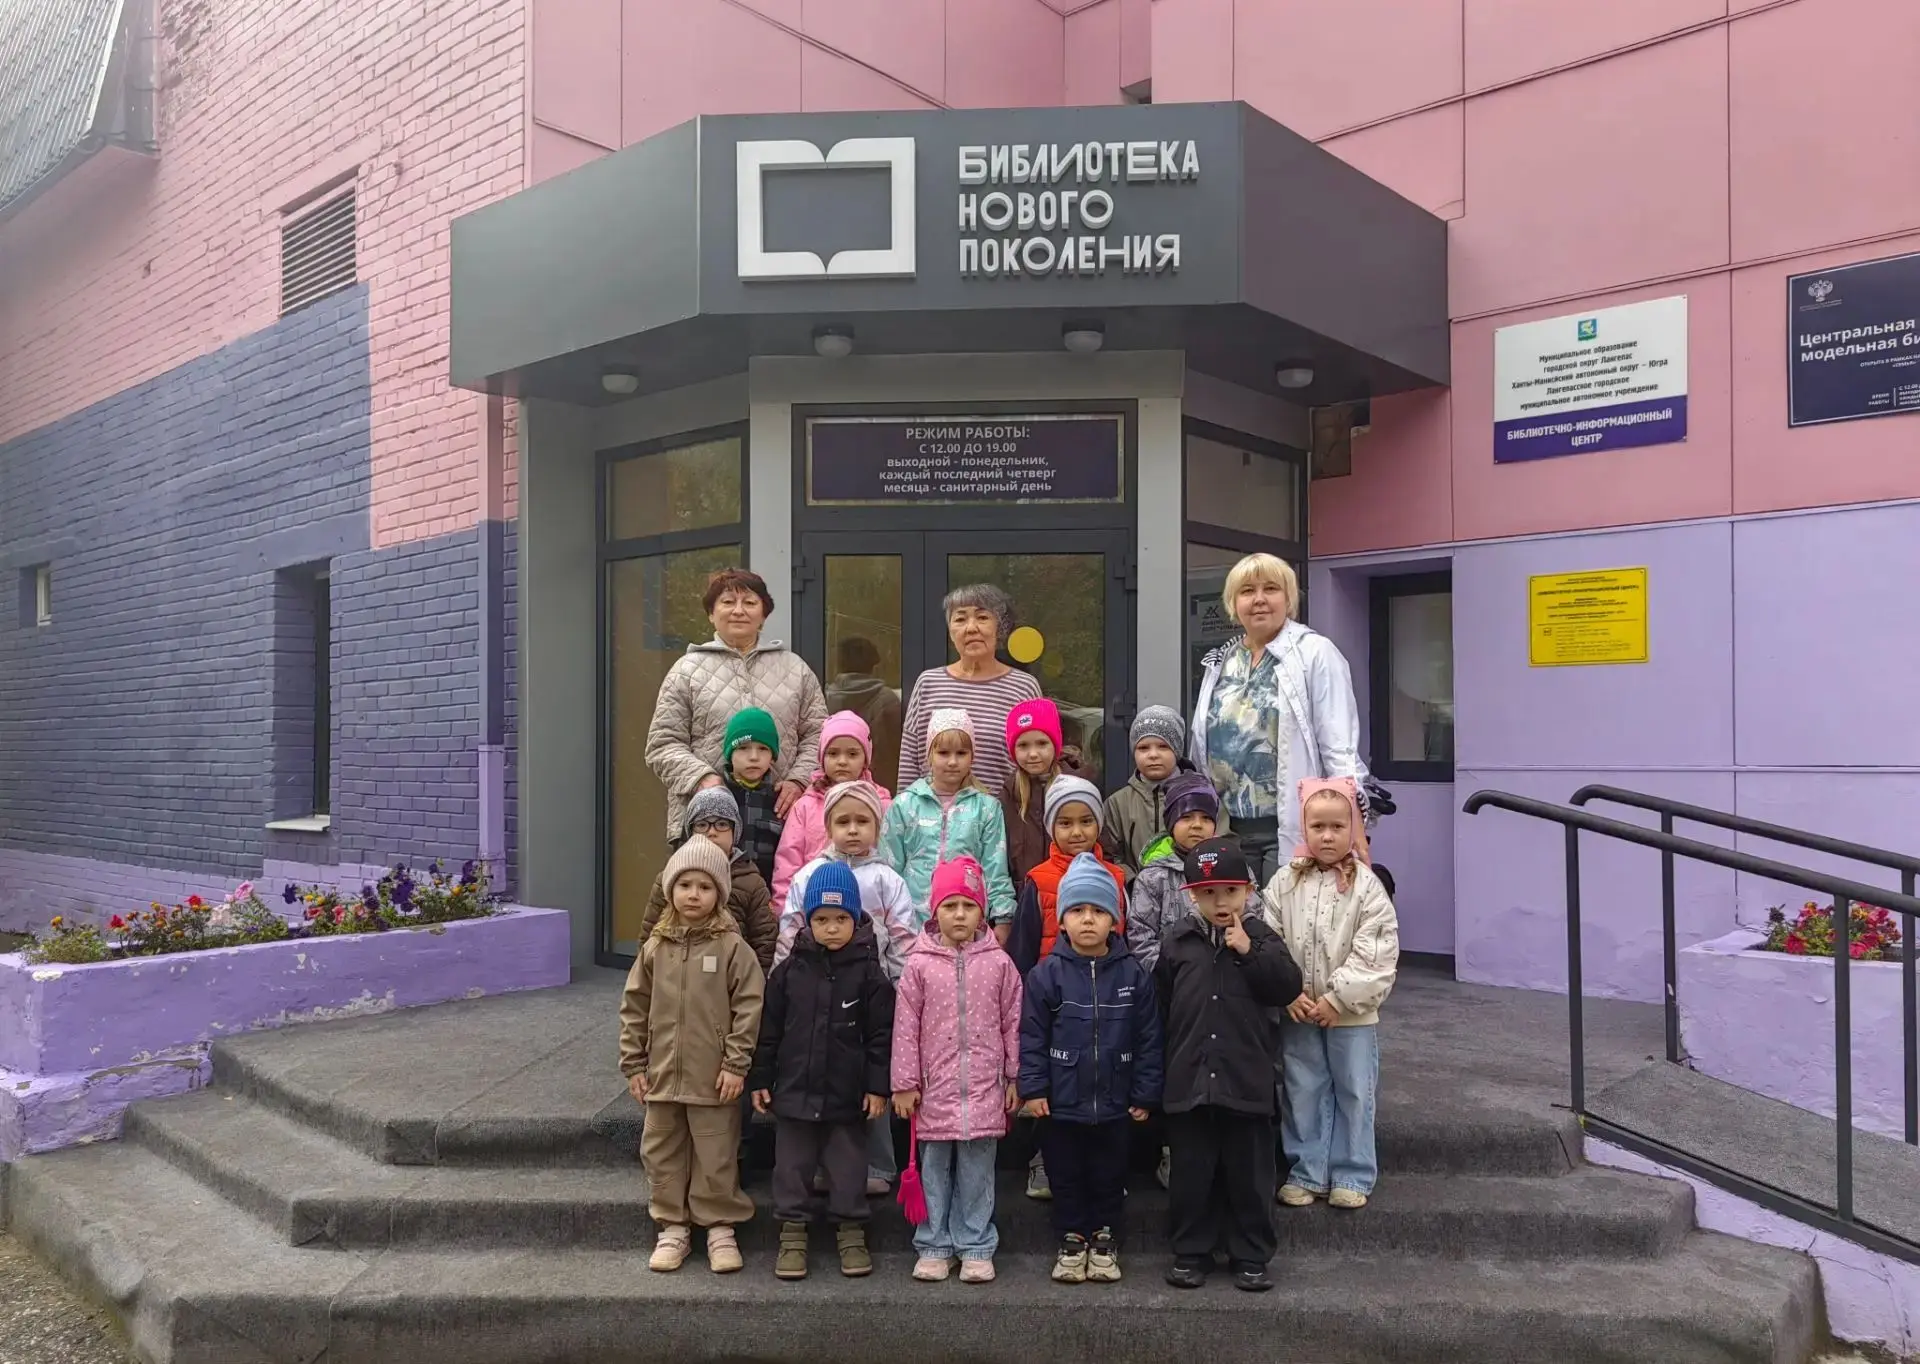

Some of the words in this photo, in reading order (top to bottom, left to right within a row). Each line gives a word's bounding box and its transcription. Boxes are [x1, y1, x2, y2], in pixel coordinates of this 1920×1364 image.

[959, 140, 1200, 184] БИБЛИОТЕКА
[959, 190, 1114, 231] НОВОГО
[959, 234, 1181, 276] ПОКОЛЕНИЯ
[1800, 319, 1916, 348] Центральная
[1538, 348, 1592, 363] Муниципальное
[1594, 340, 1638, 354] образование
[1801, 338, 1897, 362] модельная
[1544, 361, 1578, 373] городской
[1580, 358, 1598, 368] округ
[1601, 353, 1633, 364] Лангепас
[1575, 366, 1617, 380] автономный
[1620, 363, 1639, 373] округ
[1649, 359, 1668, 368] Югра
[1547, 381, 1592, 395] Лангепасское
[1594, 377, 1630, 388] городское
[1520, 397, 1571, 410] муниципальное
[1615, 384, 1658, 397] учреждение
[906, 427, 961, 439] РЕЖИМ
[965, 425, 1031, 439] РАБОТЫ:
[1507, 408, 1673, 440] БИБЛИОТЕЧНО-ИНФОРМАЦИОННЫЙ
[919, 443, 927, 454] С
[930, 443, 960, 454] 12.00
[963, 443, 983, 455] ДО
[986, 442, 1017, 453] 19.00
[1571, 433, 1603, 447] ЦЕНТР
[887, 455, 951, 469] выходной
[961, 455, 1049, 468] понедельник,
[879, 469, 931, 482] каждый
[934, 468, 1003, 480] последний
[1006, 468, 1057, 479] четверг
[884, 483, 930, 495] месяца
[939, 481, 1018, 494] санитарный
[1021, 481, 1052, 494] день
